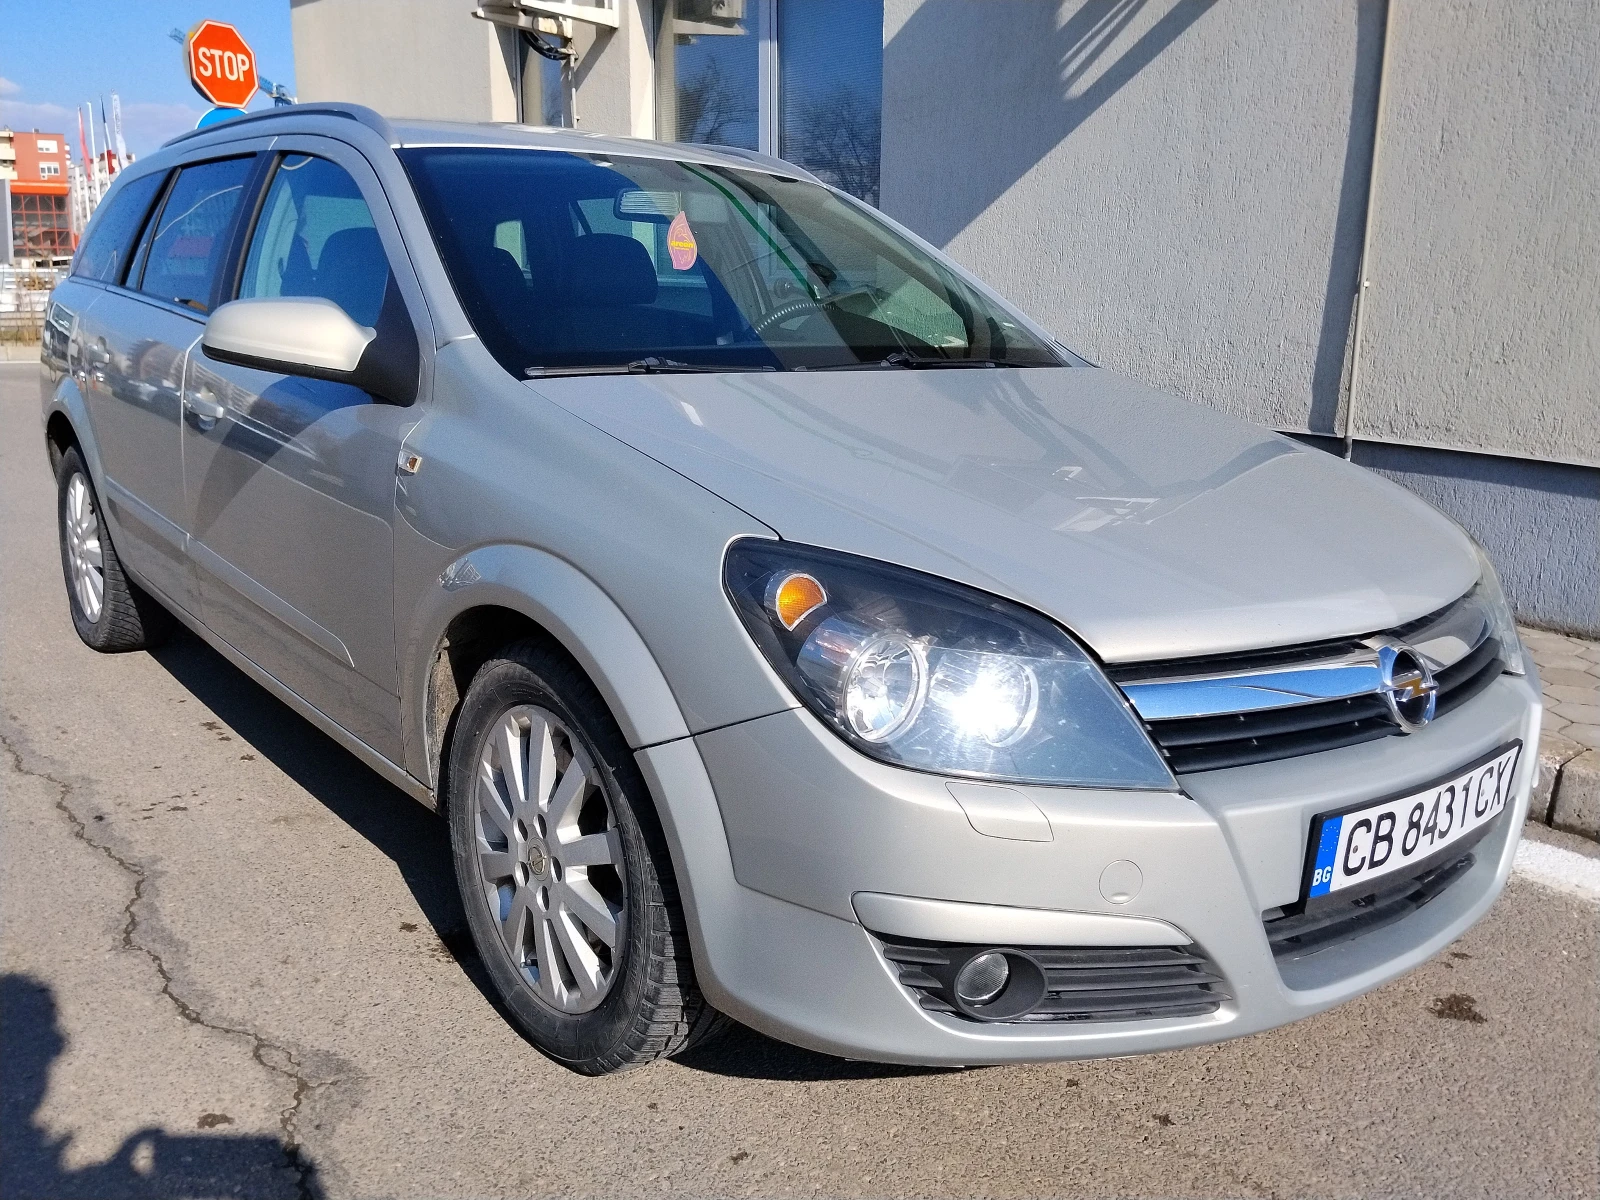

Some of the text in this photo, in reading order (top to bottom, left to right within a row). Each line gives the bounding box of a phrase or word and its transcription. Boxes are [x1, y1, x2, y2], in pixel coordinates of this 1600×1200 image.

[198, 47, 250, 82] STOP
[1342, 756, 1512, 877] CB 8431 CX
[1312, 866, 1332, 887] BG
